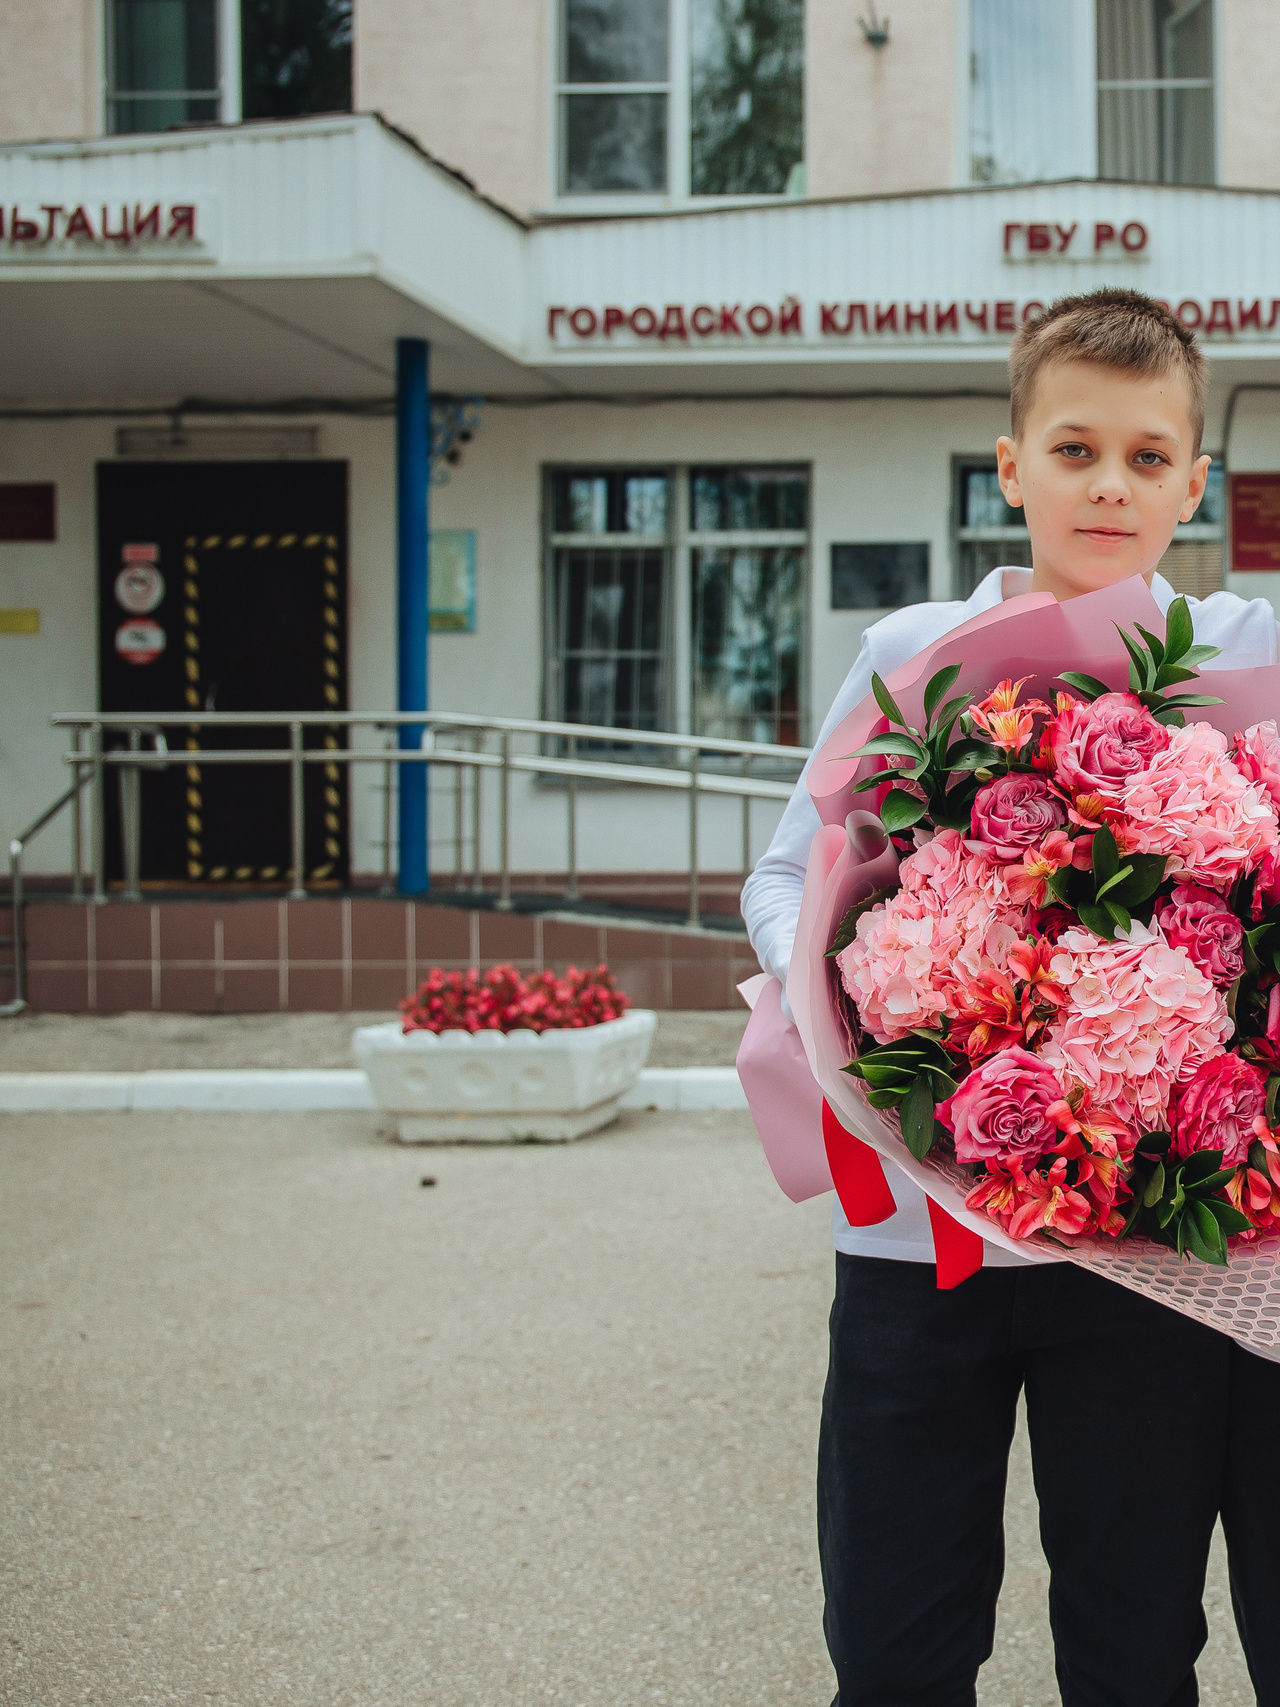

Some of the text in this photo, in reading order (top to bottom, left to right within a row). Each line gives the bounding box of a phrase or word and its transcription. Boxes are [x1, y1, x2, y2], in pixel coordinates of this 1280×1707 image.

[0, 202, 196, 244] ЬТАЦИЯ
[1003, 222, 1149, 253] ГБУ РО
[548, 295, 801, 341] ГОРОДСКОЙ
[820, 300, 1058, 336] КЛИНИЧЕС
